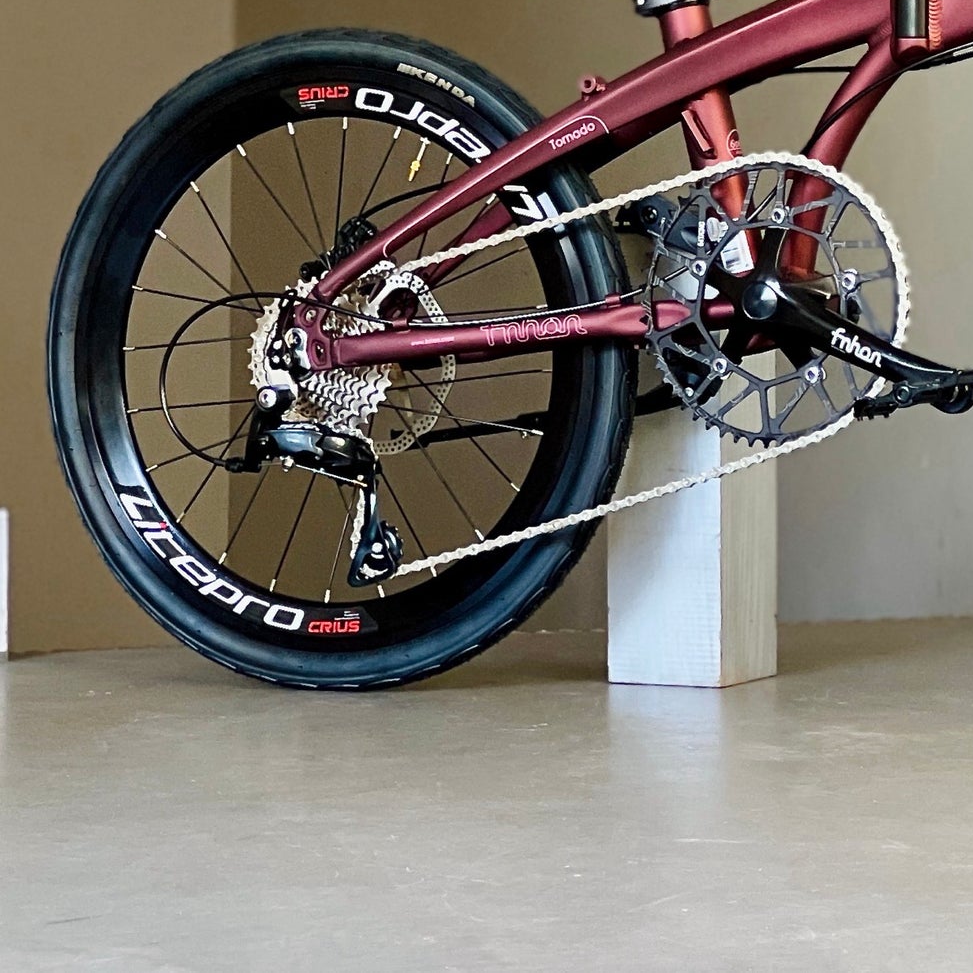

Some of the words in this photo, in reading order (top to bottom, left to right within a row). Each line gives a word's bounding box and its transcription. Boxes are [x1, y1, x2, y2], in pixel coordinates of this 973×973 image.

[298, 84, 350, 101] CRIUS
[407, 65, 476, 108] KENDA
[830, 327, 882, 369] fnhon
[308, 620, 361, 634] CRIUS
